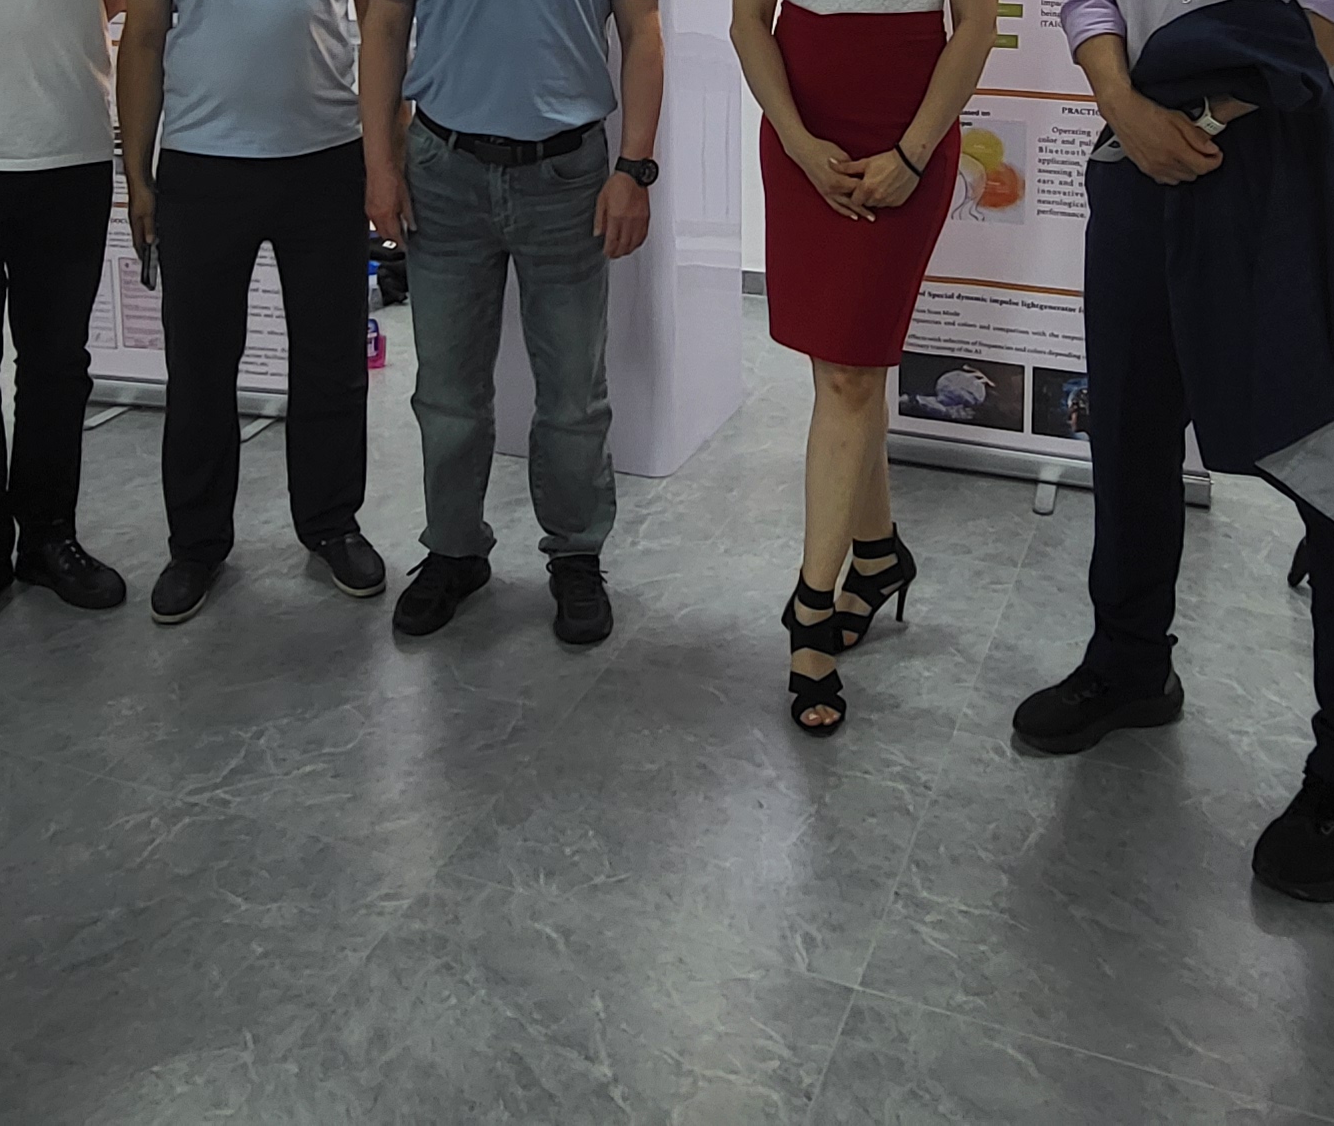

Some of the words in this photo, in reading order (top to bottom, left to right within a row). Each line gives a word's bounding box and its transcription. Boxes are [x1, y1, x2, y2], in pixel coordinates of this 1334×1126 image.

[1052, 126, 1091, 137] Operating
[1037, 136, 1057, 144] color
[1038, 146, 1087, 156] Bluetooth
[1037, 157, 1083, 167] application,
[1037, 188, 1085, 197] innovative
[927, 291, 955, 300] Special
[956, 294, 987, 303] dynamic
[1021, 300, 1077, 313] lightgenerator
